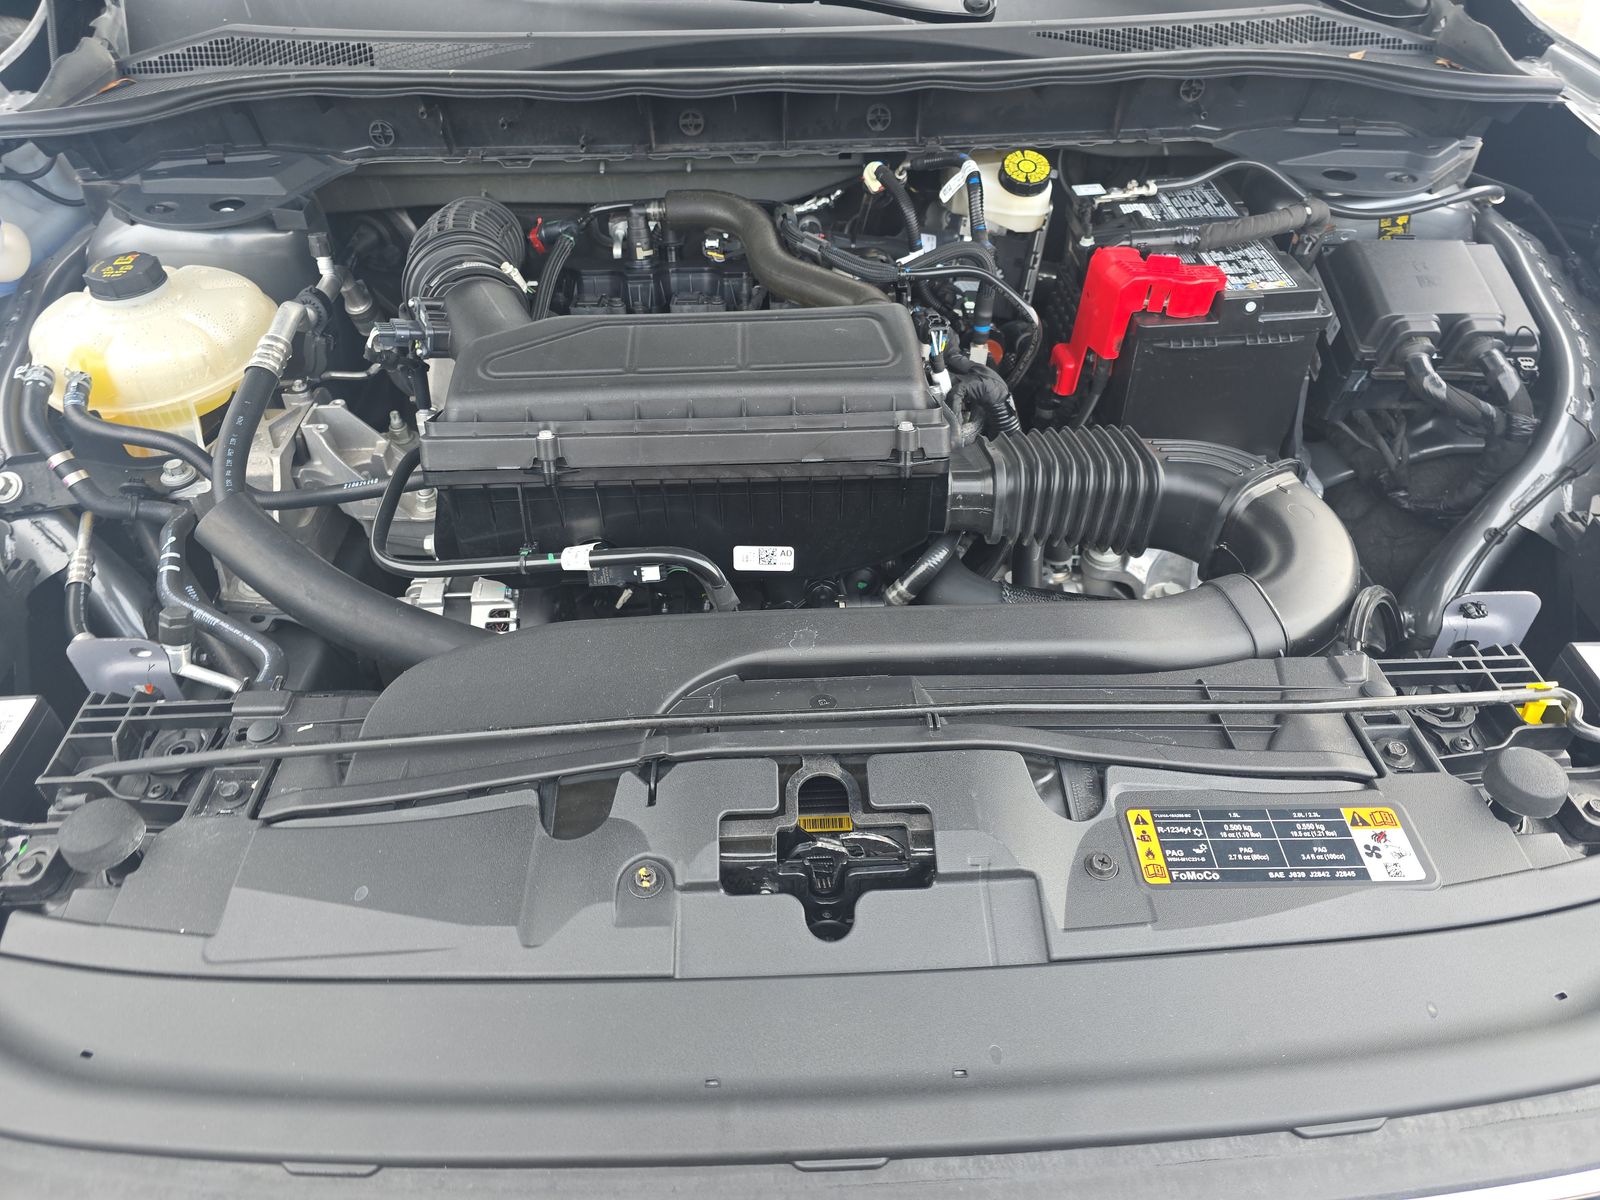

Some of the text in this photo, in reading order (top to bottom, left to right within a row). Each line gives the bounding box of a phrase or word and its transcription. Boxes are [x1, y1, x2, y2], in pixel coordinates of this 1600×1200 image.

[1157, 826, 1191, 834] R-1234yf
[1243, 824, 1252, 832] kg
[1315, 823, 1325, 831] kg
[1171, 871, 1220, 880] FoMoCo
